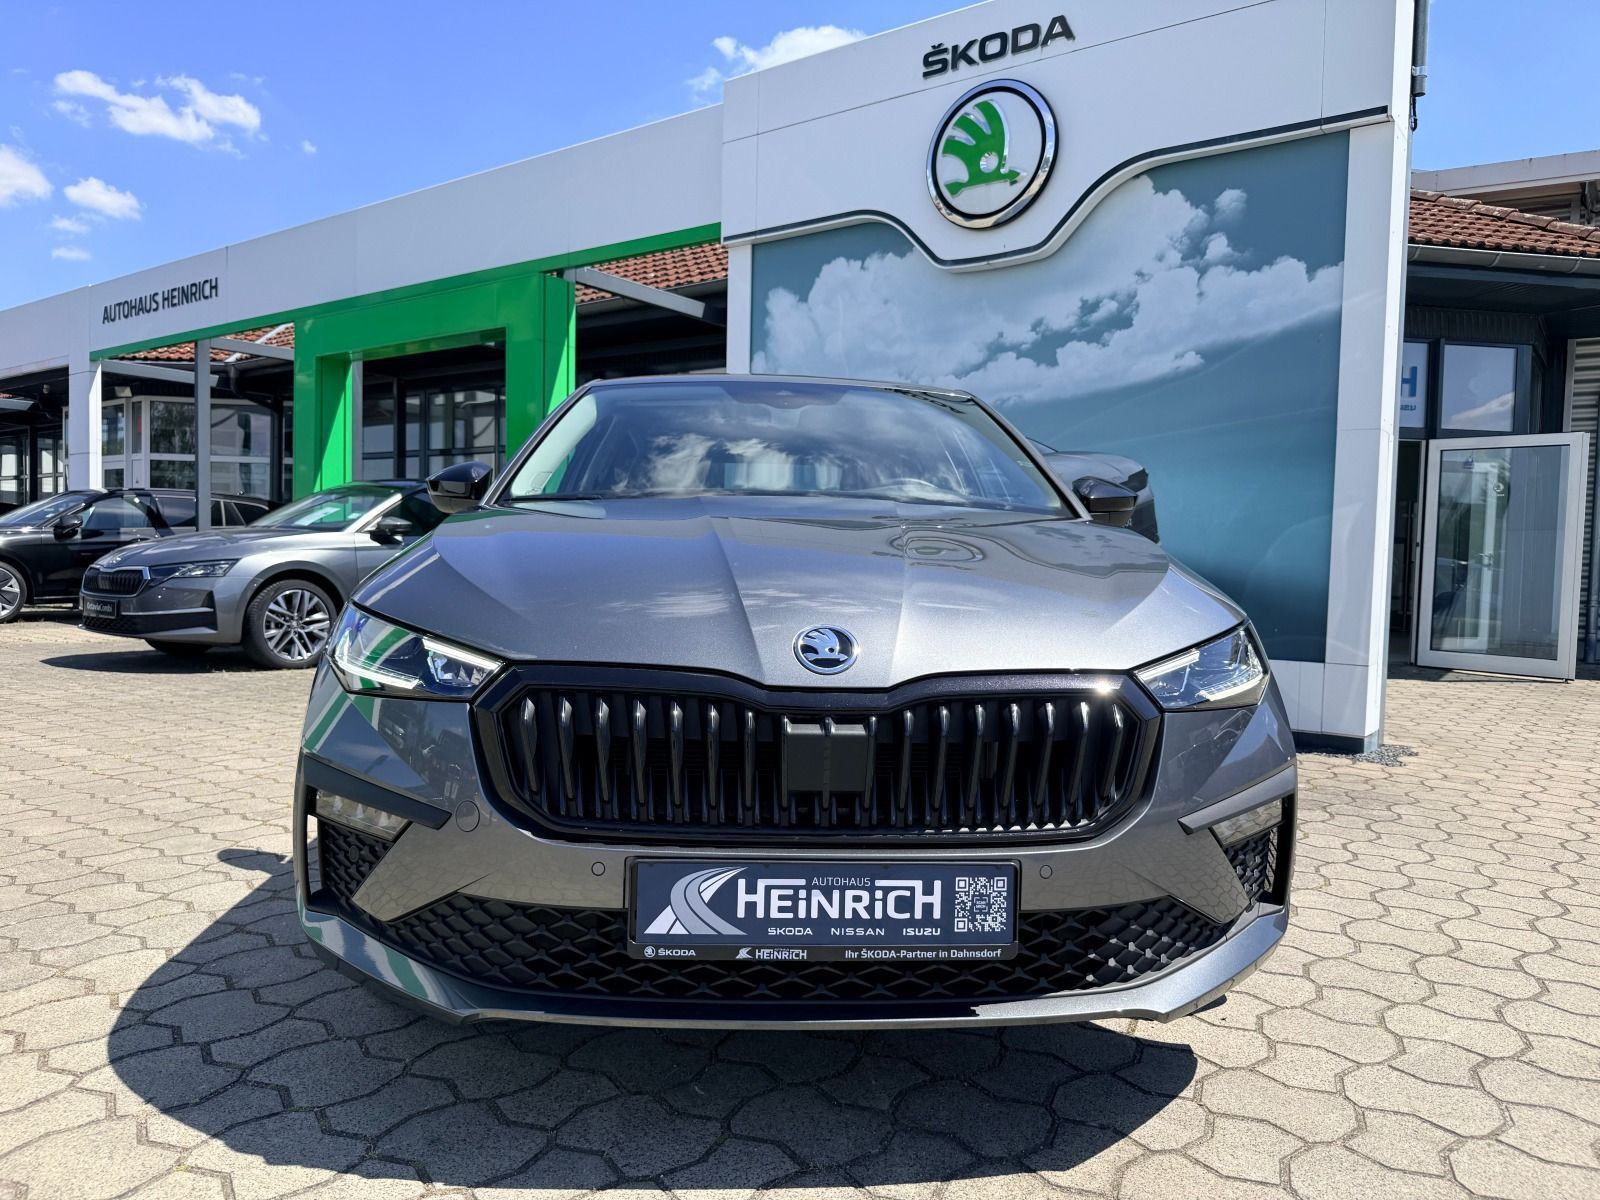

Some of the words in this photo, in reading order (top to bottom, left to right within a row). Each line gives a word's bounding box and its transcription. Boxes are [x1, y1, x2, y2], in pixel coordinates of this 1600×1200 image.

[922, 15, 1075, 79] ŠKODA
[102, 292, 159, 324] AUTOHAUS
[161, 277, 219, 310] HEINRICH
[811, 877, 871, 887] AUTOHAUS
[830, 927, 885, 936] NISSAN
[902, 927, 941, 936] ISUZU
[657, 947, 696, 957] ŠKODA
[845, 949, 859, 959] Ihr
[860, 948, 936, 959] ŠKODA-Partner
[938, 949, 948, 958] in
[950, 949, 1002, 958] Dahnsdorf
